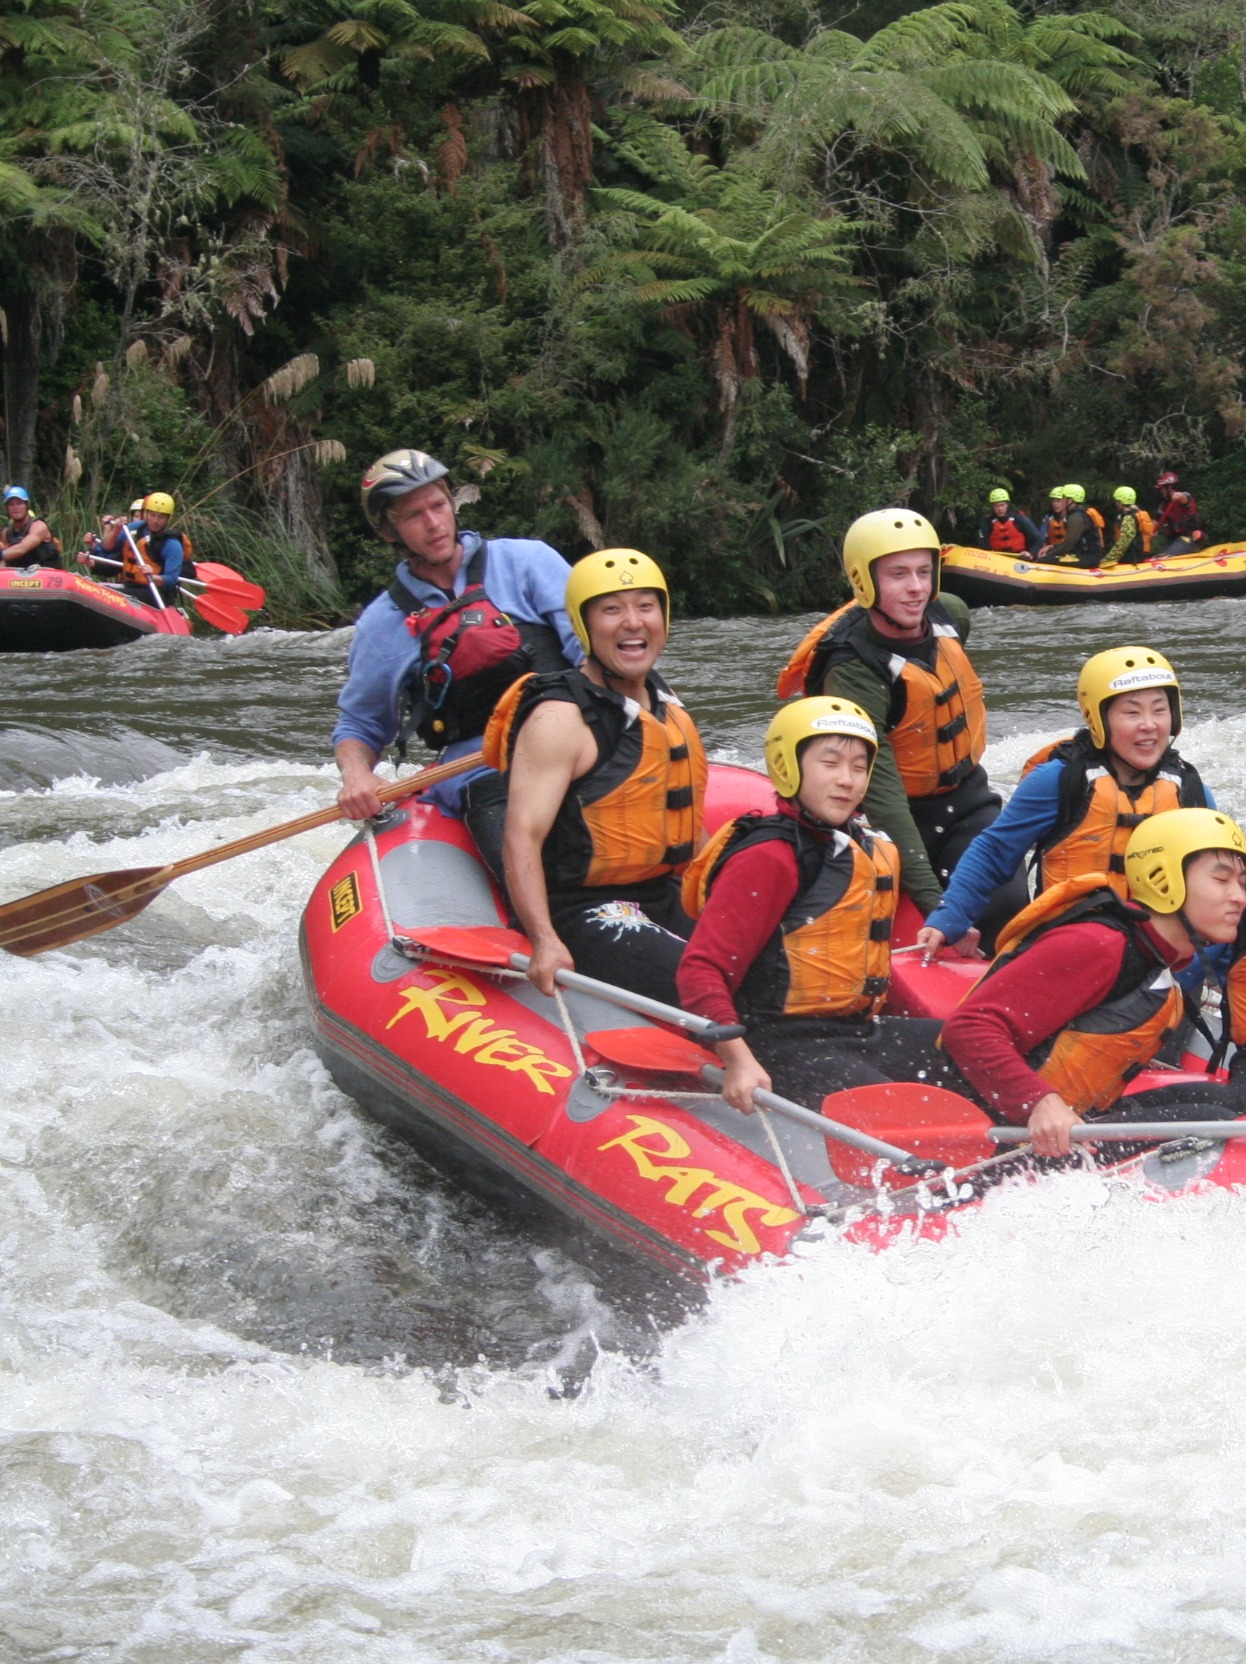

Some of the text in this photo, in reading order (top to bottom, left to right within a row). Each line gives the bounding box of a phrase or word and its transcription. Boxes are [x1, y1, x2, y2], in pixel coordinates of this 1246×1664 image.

[10, 580, 40, 588] INCEPT
[46, 576, 63, 588] 79
[1113, 672, 1173, 689] Raftabout
[332, 876, 356, 923] INCEPT
[385, 968, 573, 1096] RIVER
[597, 1114, 802, 1255] RATS
